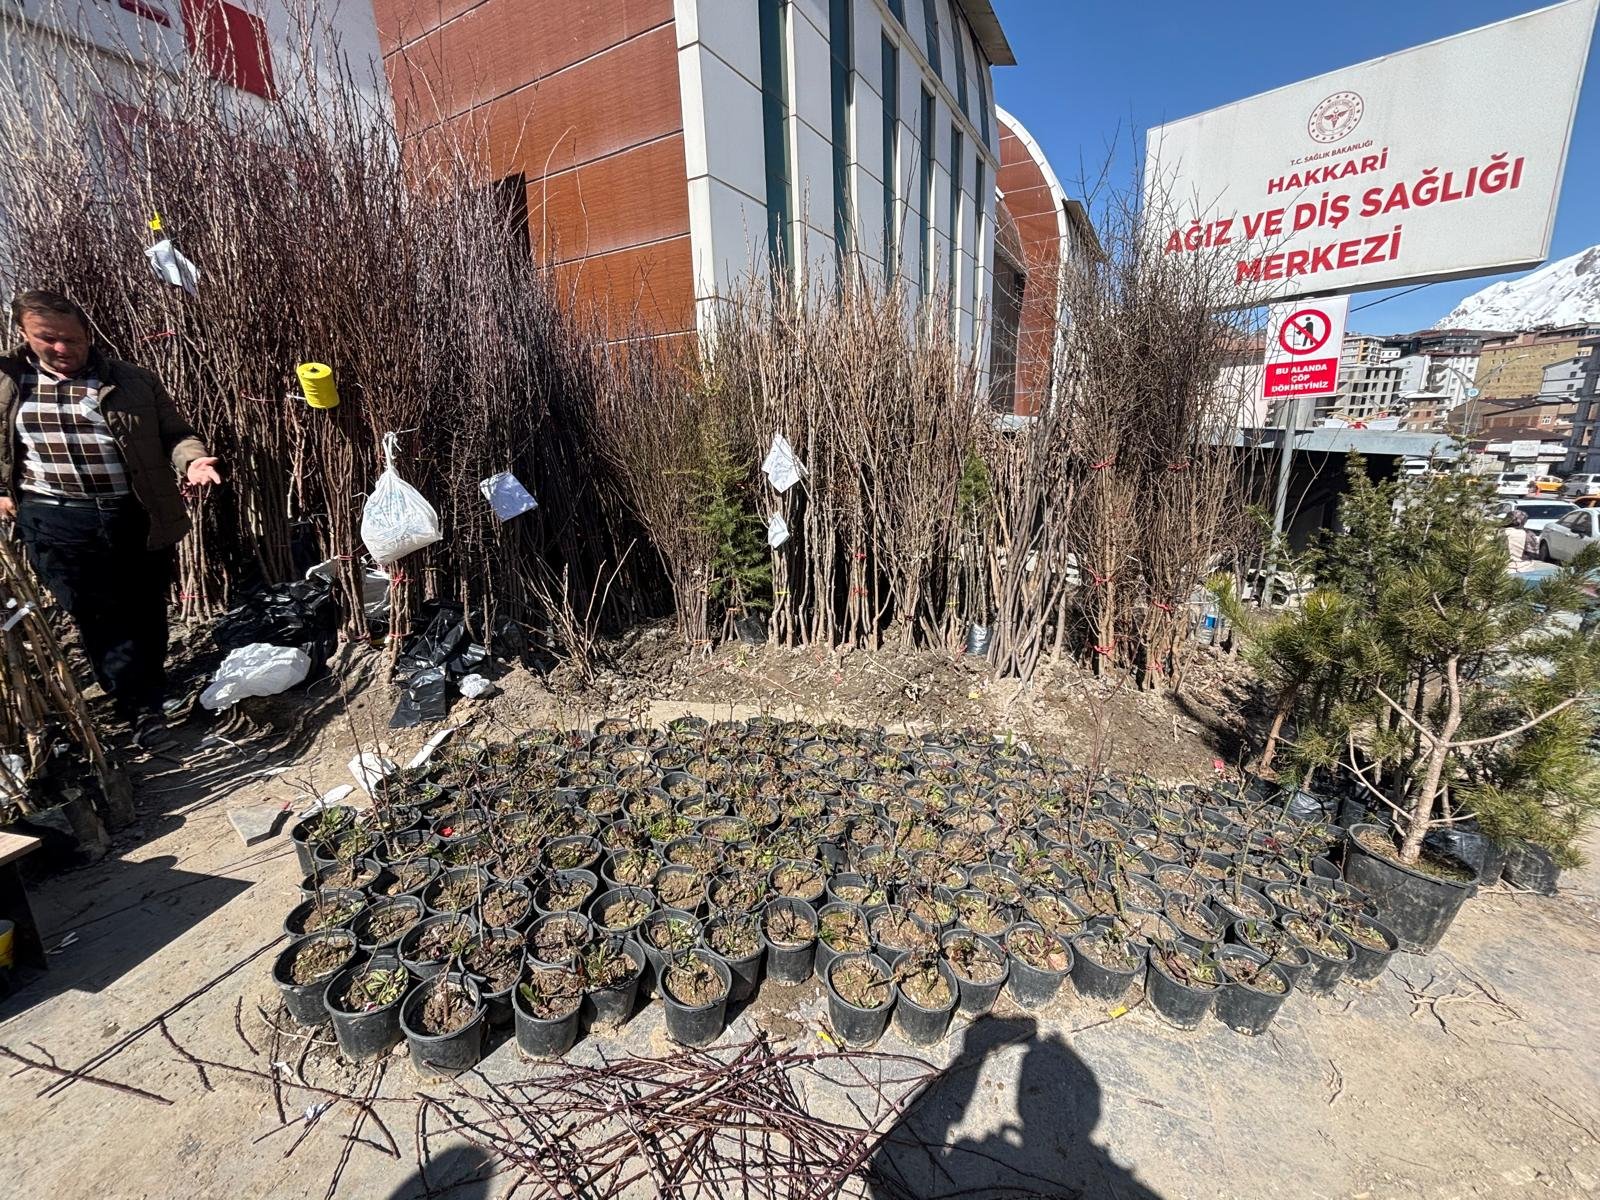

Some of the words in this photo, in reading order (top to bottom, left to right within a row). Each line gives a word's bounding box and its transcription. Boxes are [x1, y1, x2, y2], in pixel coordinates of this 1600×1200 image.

[1304, 152, 1330, 163] SAĞLIK
[1331, 140, 1373, 157] BAKANLIĞI
[1267, 147, 1389, 194] HAKKARİ
[1164, 218, 1234, 255] AĞIZ
[1242, 207, 1285, 240] VE
[1292, 191, 1350, 229] DİŞ
[1359, 152, 1525, 217] SAĞLIĞI
[1234, 224, 1402, 286] MERKEZİ
[1275, 367, 1289, 375] BU
[1291, 364, 1327, 374] ALANDA
[1291, 374, 1310, 383] ÇÖP
[1271, 381, 1329, 393] DÖKMEYİNİZ
